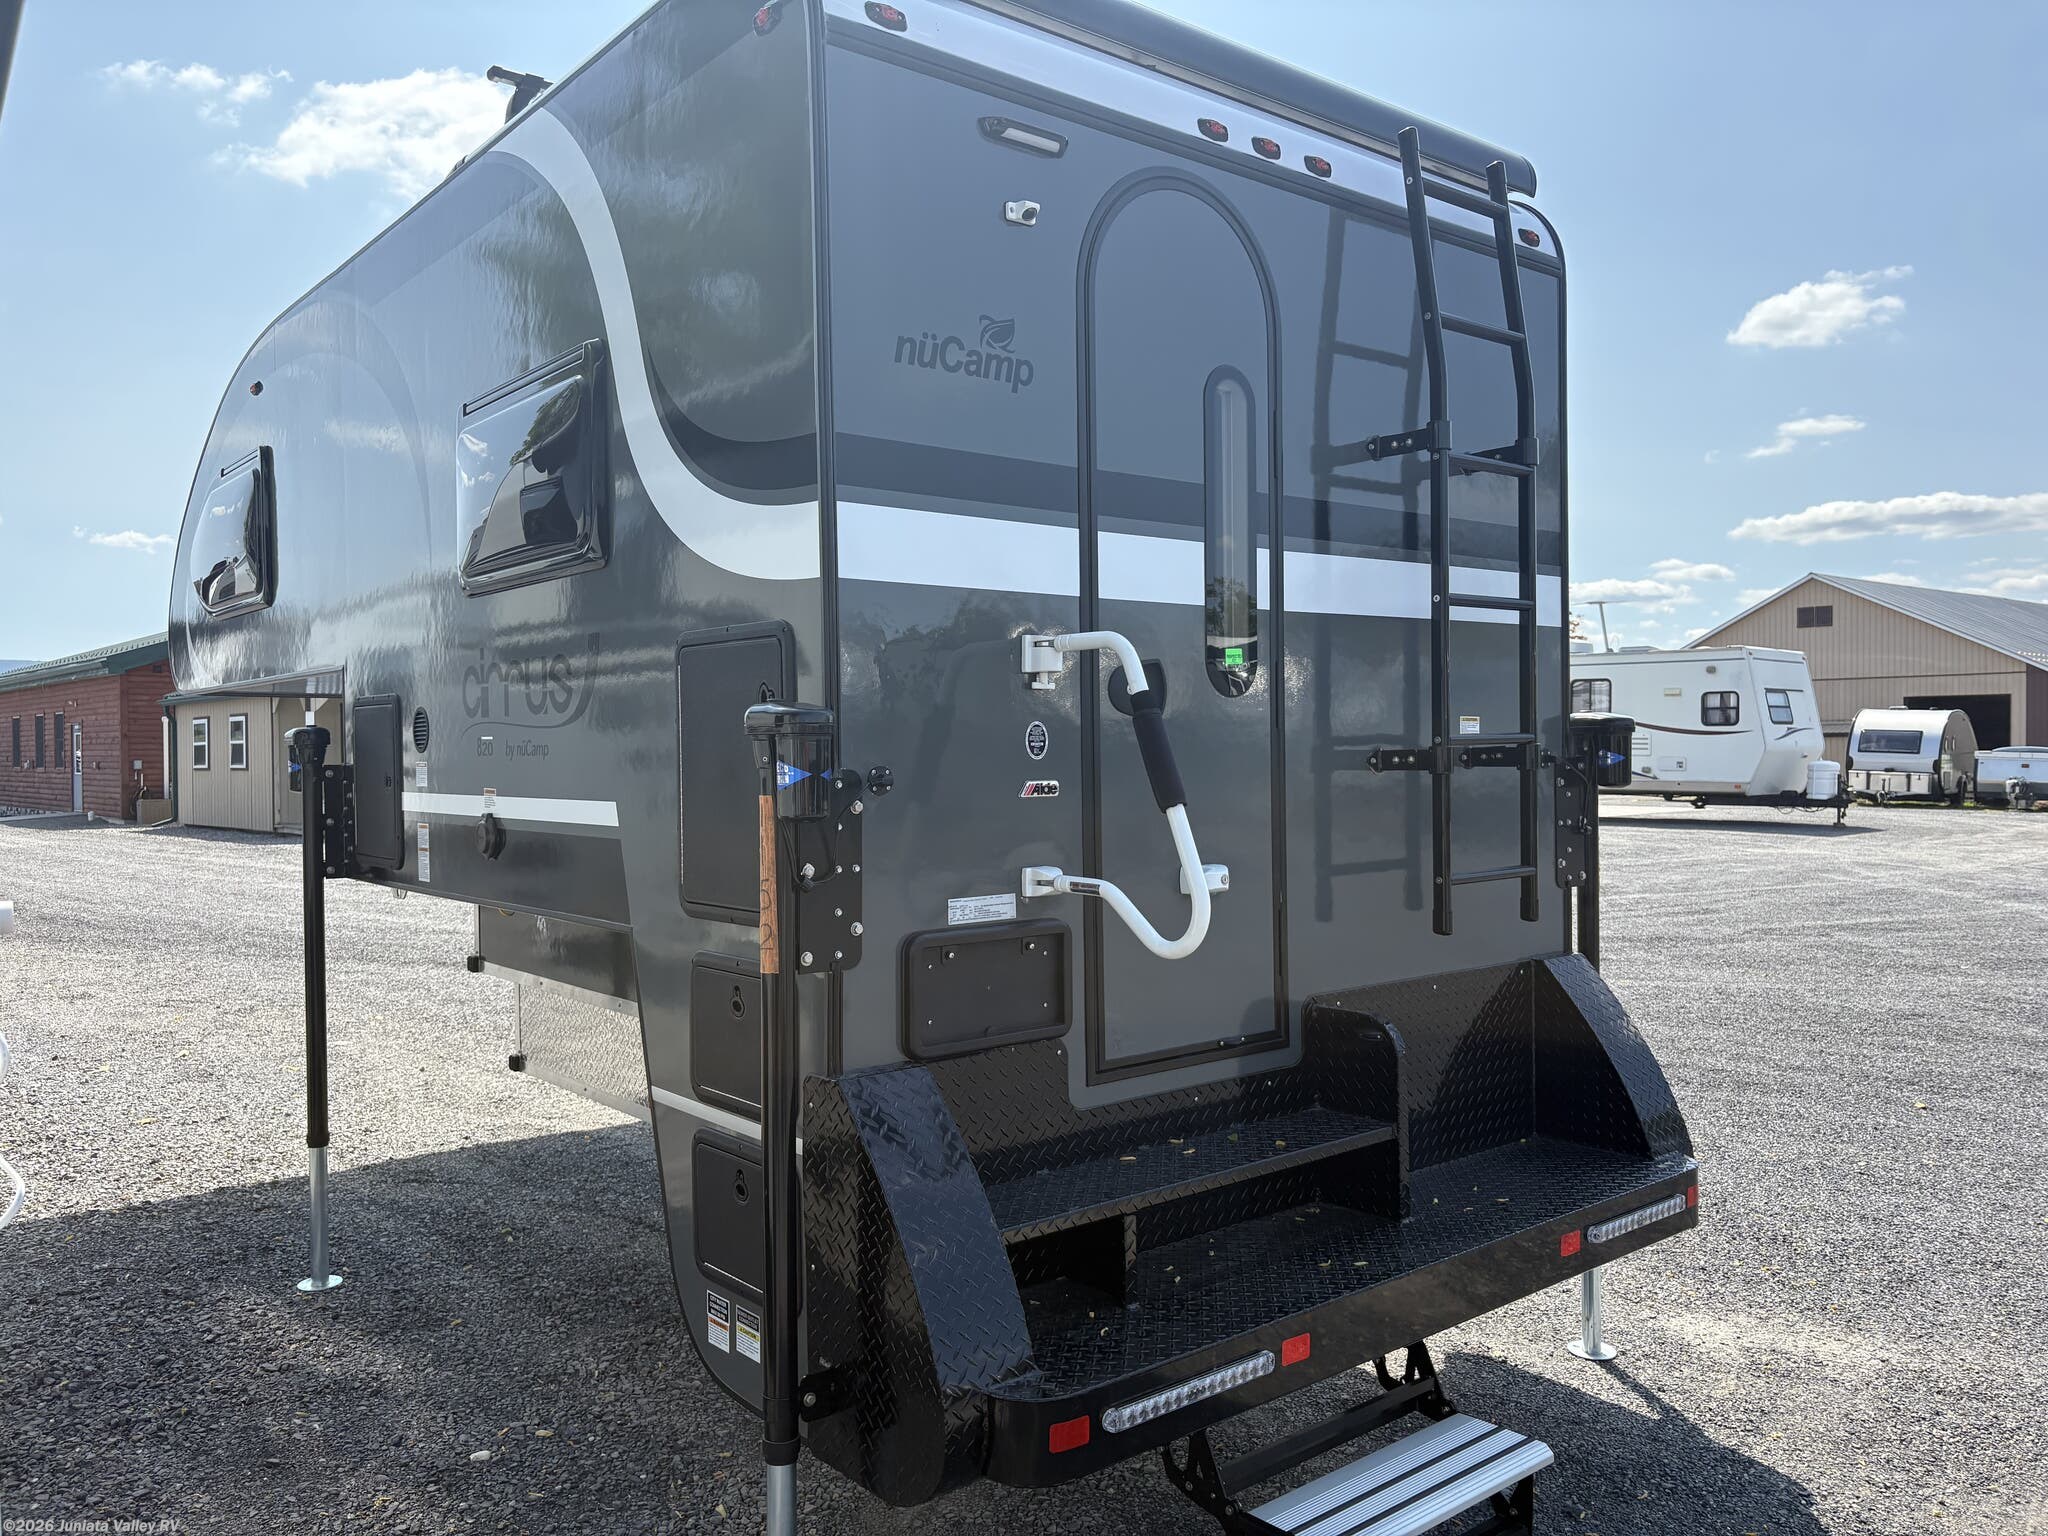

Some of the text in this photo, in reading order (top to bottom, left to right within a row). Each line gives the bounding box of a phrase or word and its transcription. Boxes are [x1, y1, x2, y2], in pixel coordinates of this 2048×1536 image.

[894, 331, 1034, 394] nüCamp
[461, 647, 576, 719] cirrus
[476, 737, 494, 757] 820
[505, 739, 550, 761] by nüCamp
